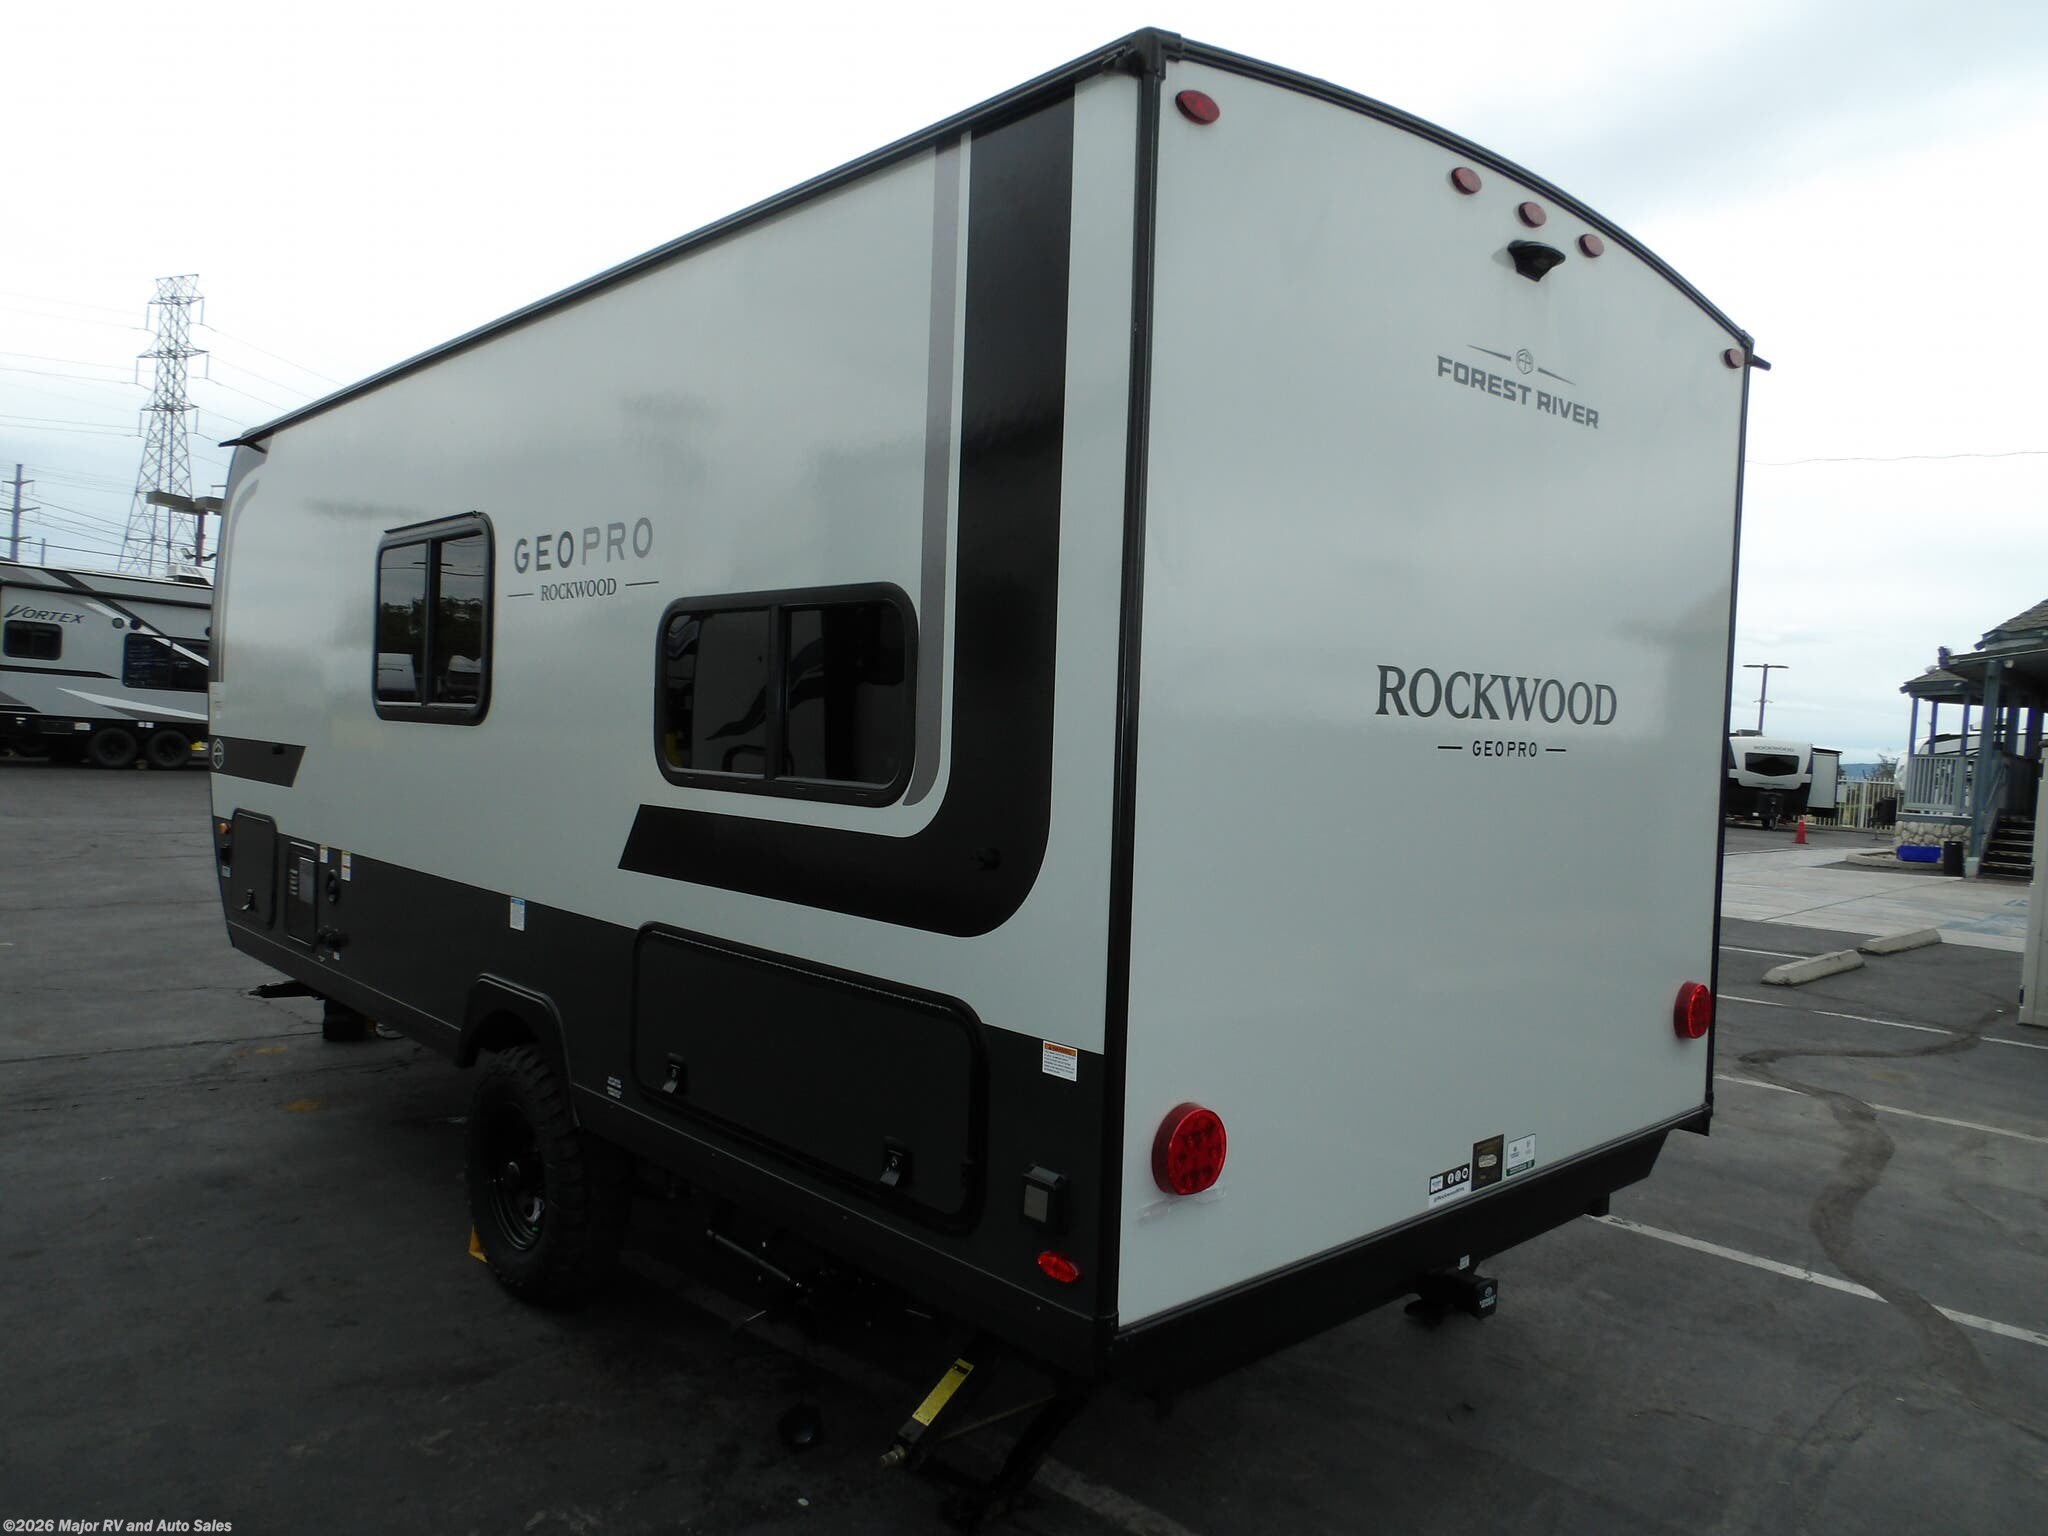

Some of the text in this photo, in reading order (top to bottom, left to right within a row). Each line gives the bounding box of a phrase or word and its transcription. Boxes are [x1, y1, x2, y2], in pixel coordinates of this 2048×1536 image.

[1437, 355, 1600, 429] FOREST RIVER
[541, 578, 617, 601] ROCKWOOD
[4, 605, 85, 624] VORTEX
[1375, 664, 1617, 726] ROCKWOOD
[1472, 740, 1537, 757] GEOPRO
